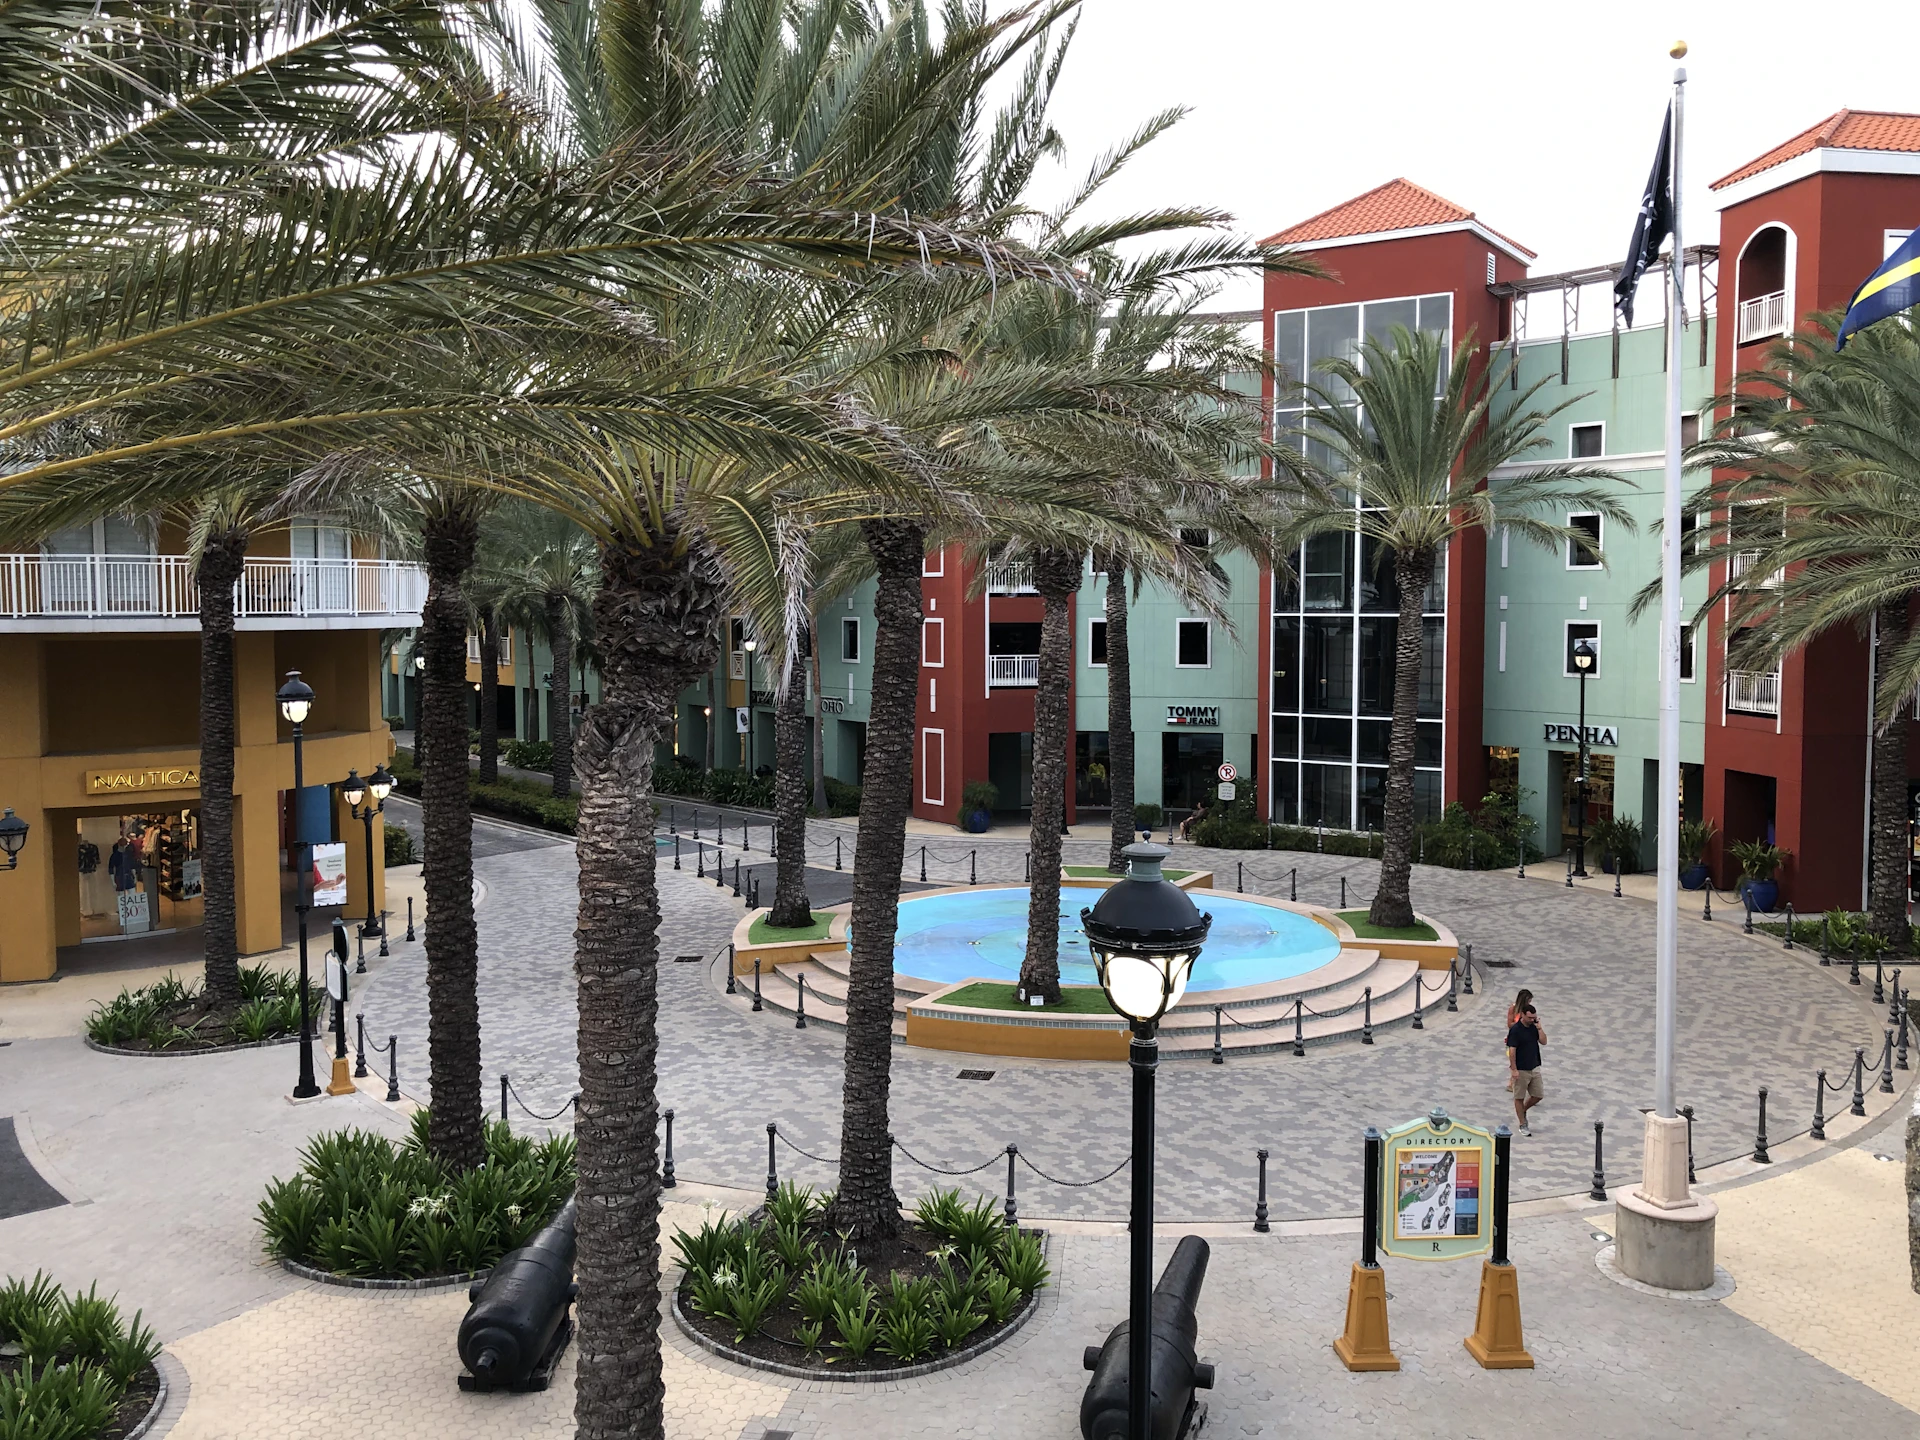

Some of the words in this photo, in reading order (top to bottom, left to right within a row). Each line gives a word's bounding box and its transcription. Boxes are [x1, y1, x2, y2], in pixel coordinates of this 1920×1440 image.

[1167, 706, 1217, 717] TOMMY
[1187, 717, 1217, 725] JEANS
[1543, 724, 1616, 745] PENHA
[94, 769, 199, 789] NAUTICA
[120, 893, 147, 906] SALE
[1406, 1137, 1473, 1146] DIRECTORY
[1432, 1242, 1441, 1252] R
